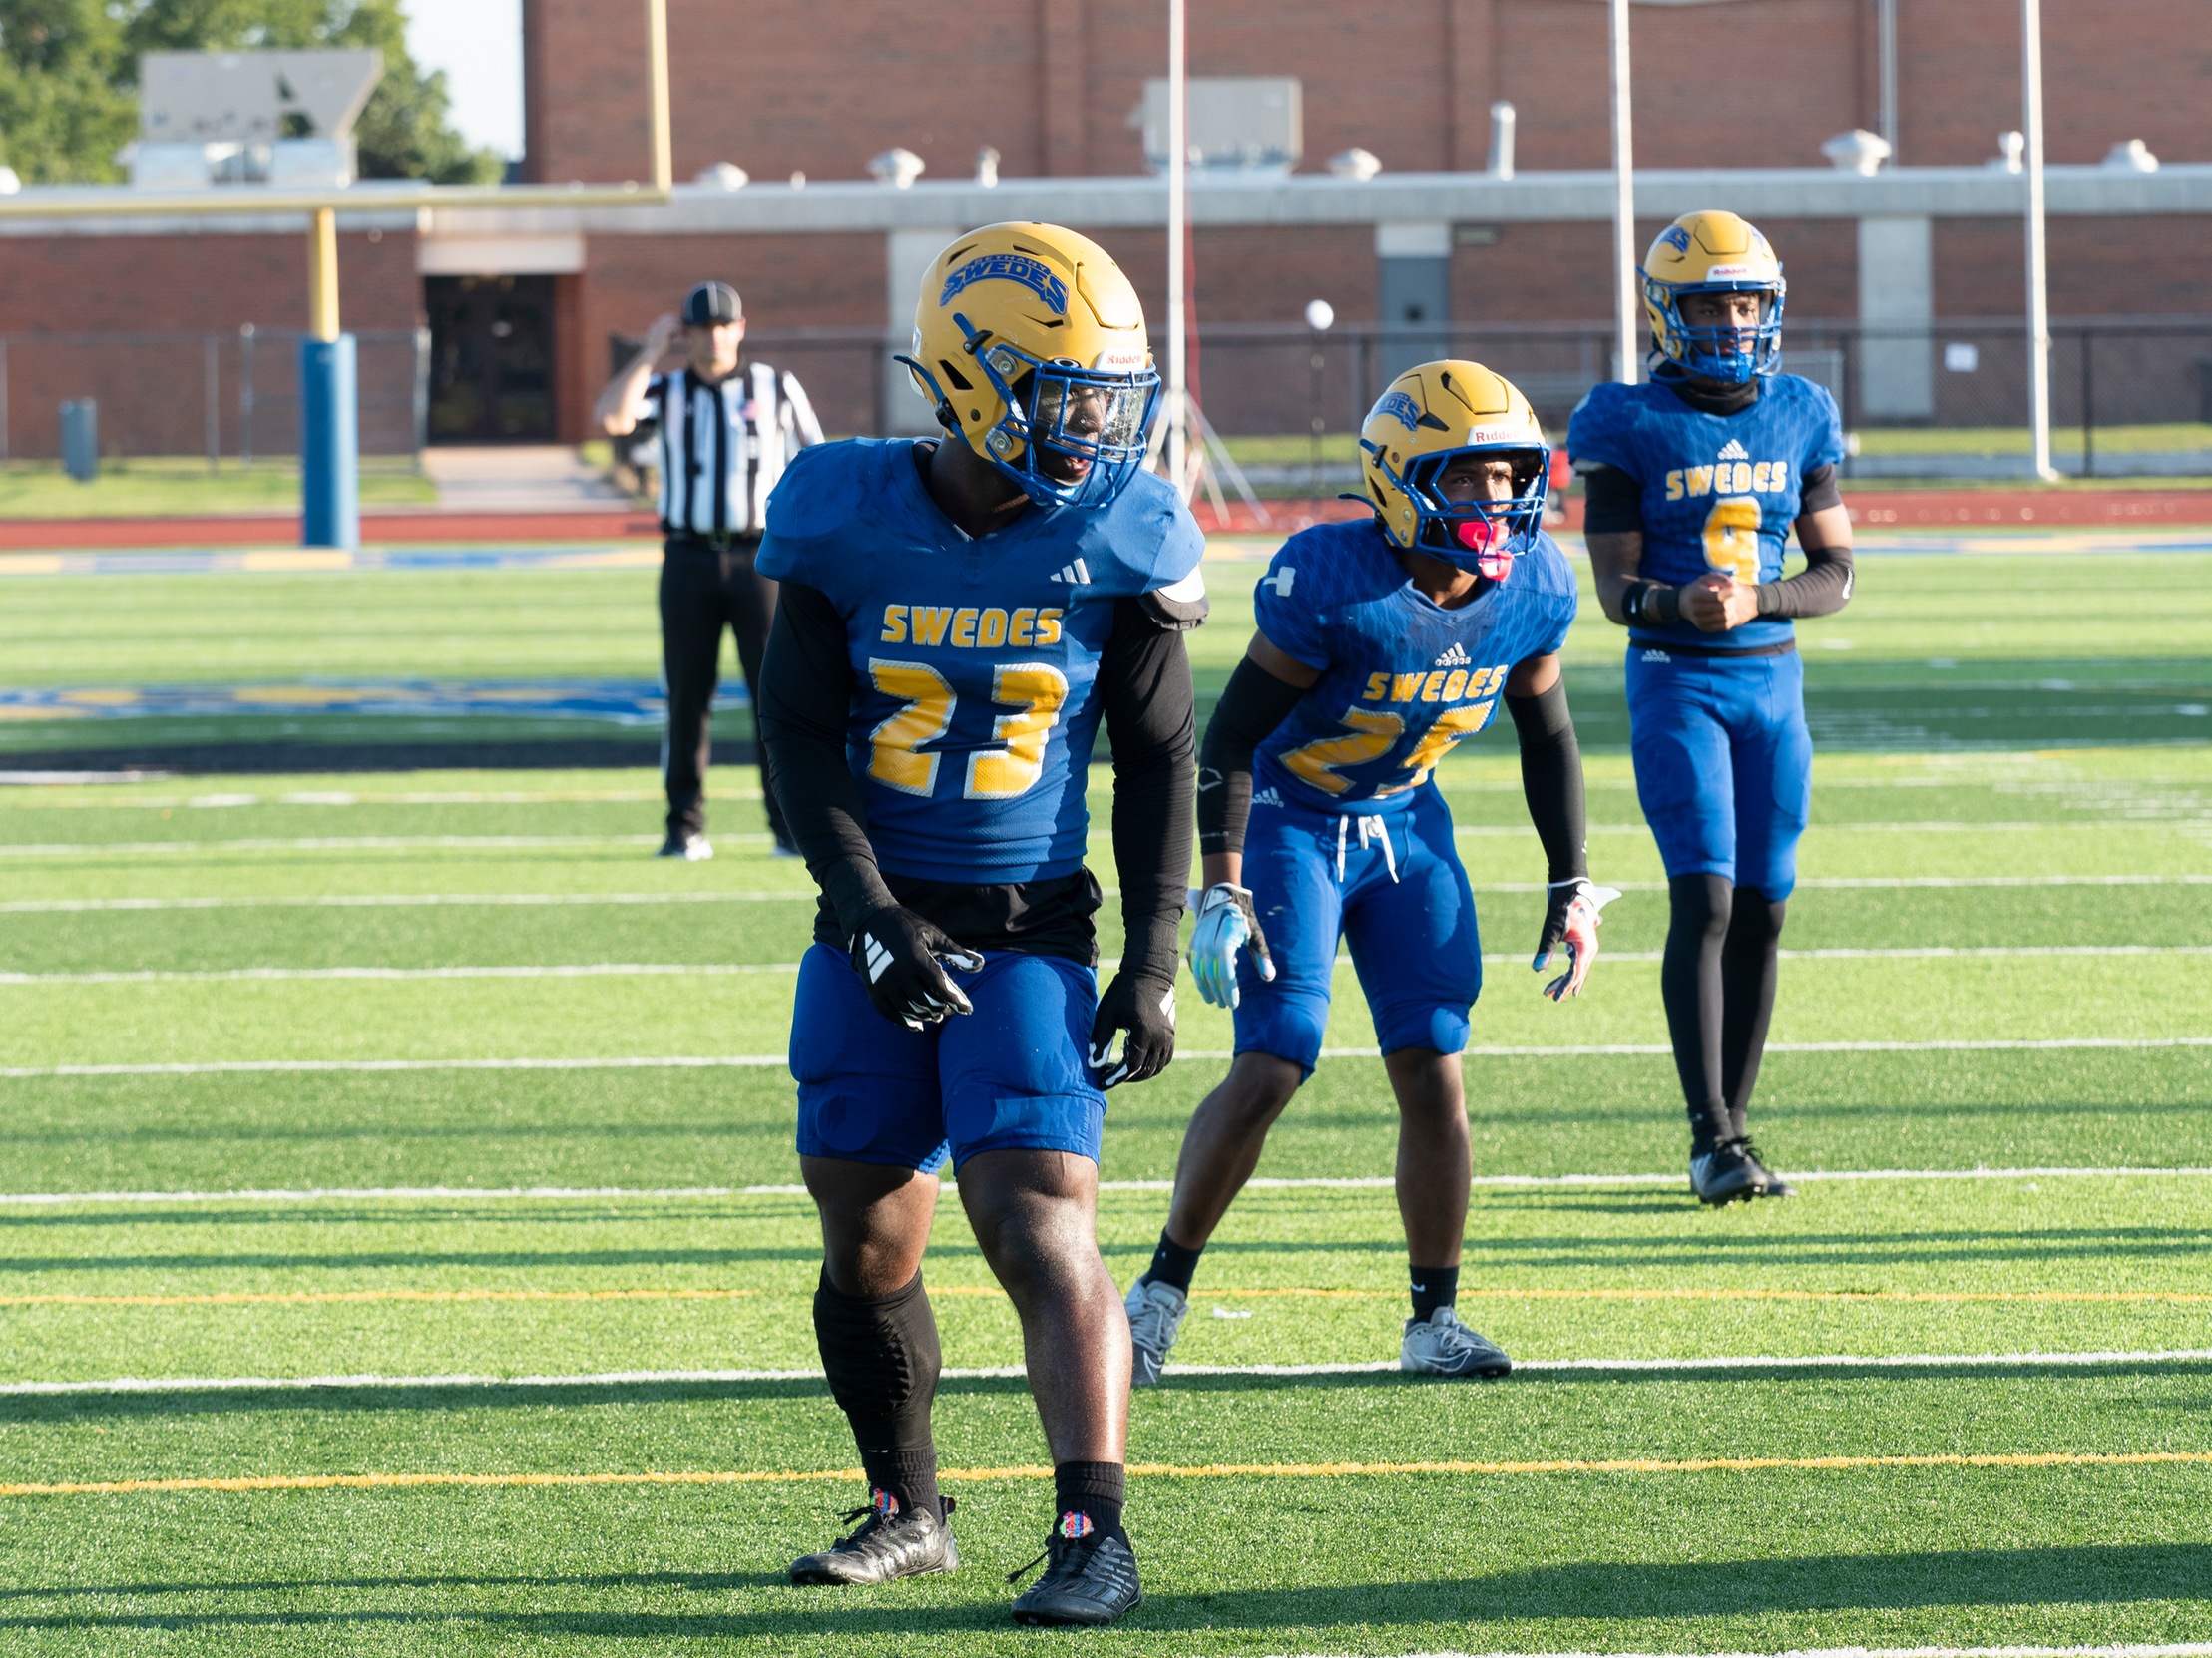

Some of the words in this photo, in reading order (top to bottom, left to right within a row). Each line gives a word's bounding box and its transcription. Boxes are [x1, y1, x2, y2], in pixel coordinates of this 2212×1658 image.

[940, 259, 1069, 315] SWEDES
[1666, 461, 1788, 501] SWEDES
[881, 604, 1064, 648] SWEDES
[1435, 655, 1472, 667] adidas
[1362, 664, 1509, 703] SWEDES
[866, 656, 1070, 800] 23
